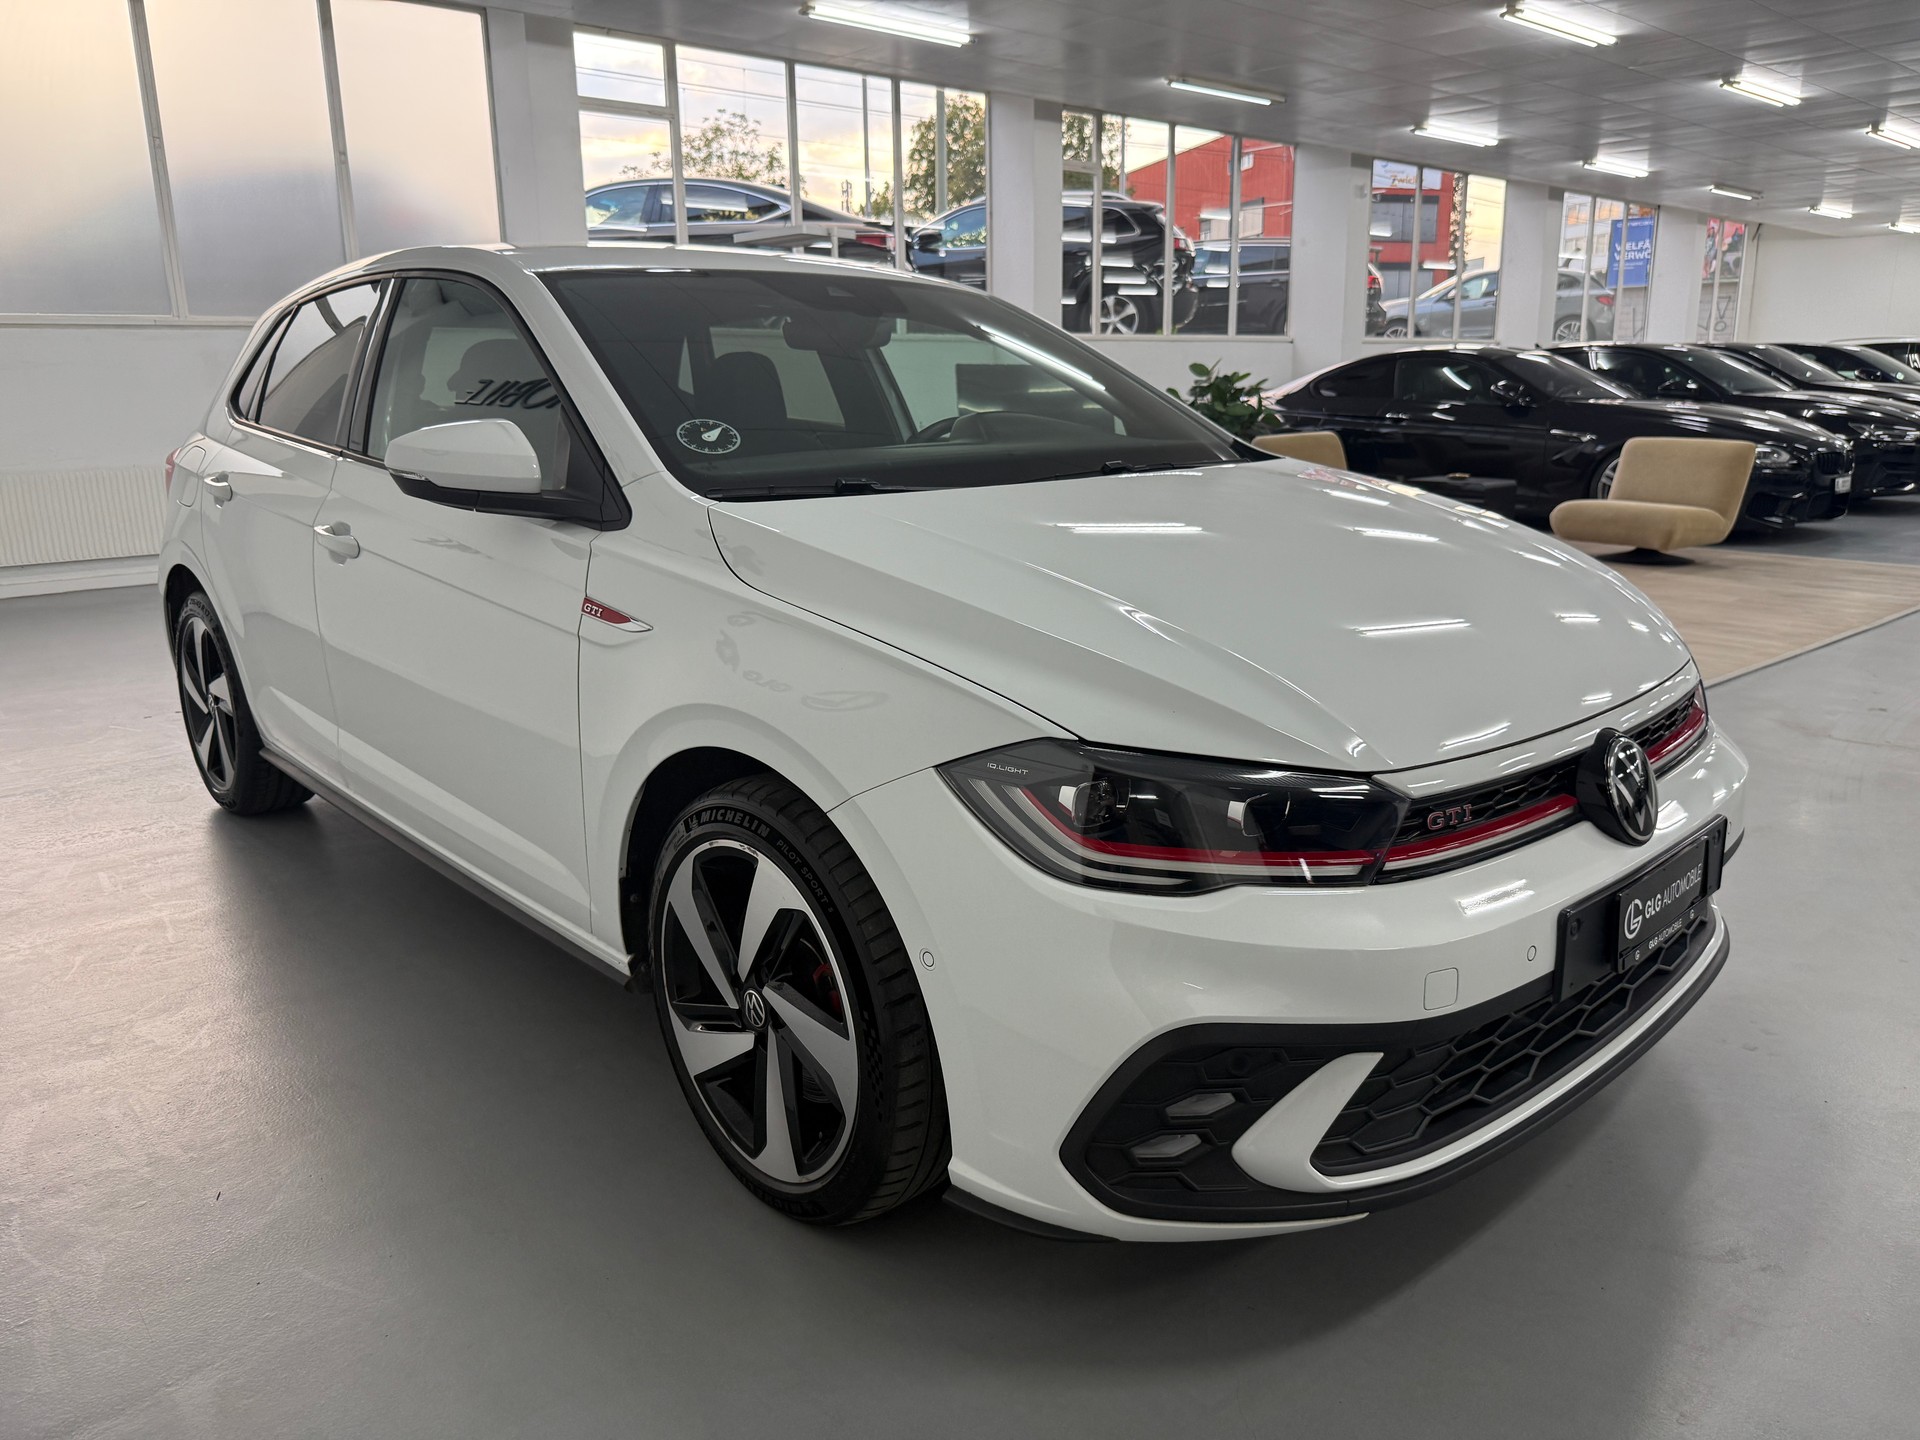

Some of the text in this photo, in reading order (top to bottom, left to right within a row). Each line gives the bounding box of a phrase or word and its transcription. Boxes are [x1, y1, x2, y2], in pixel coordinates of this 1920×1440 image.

[583, 603, 603, 617] GTI
[986, 762, 1029, 775] IQ.LIGHT
[700, 808, 770, 838] MICHELIN
[1427, 803, 1472, 831] GTI
[776, 839, 802, 865] PILOT
[800, 866, 829, 903] SPORT
[1645, 863, 1702, 919] GLG AUTOMOBILE
[1648, 936, 1658, 949] GLG
